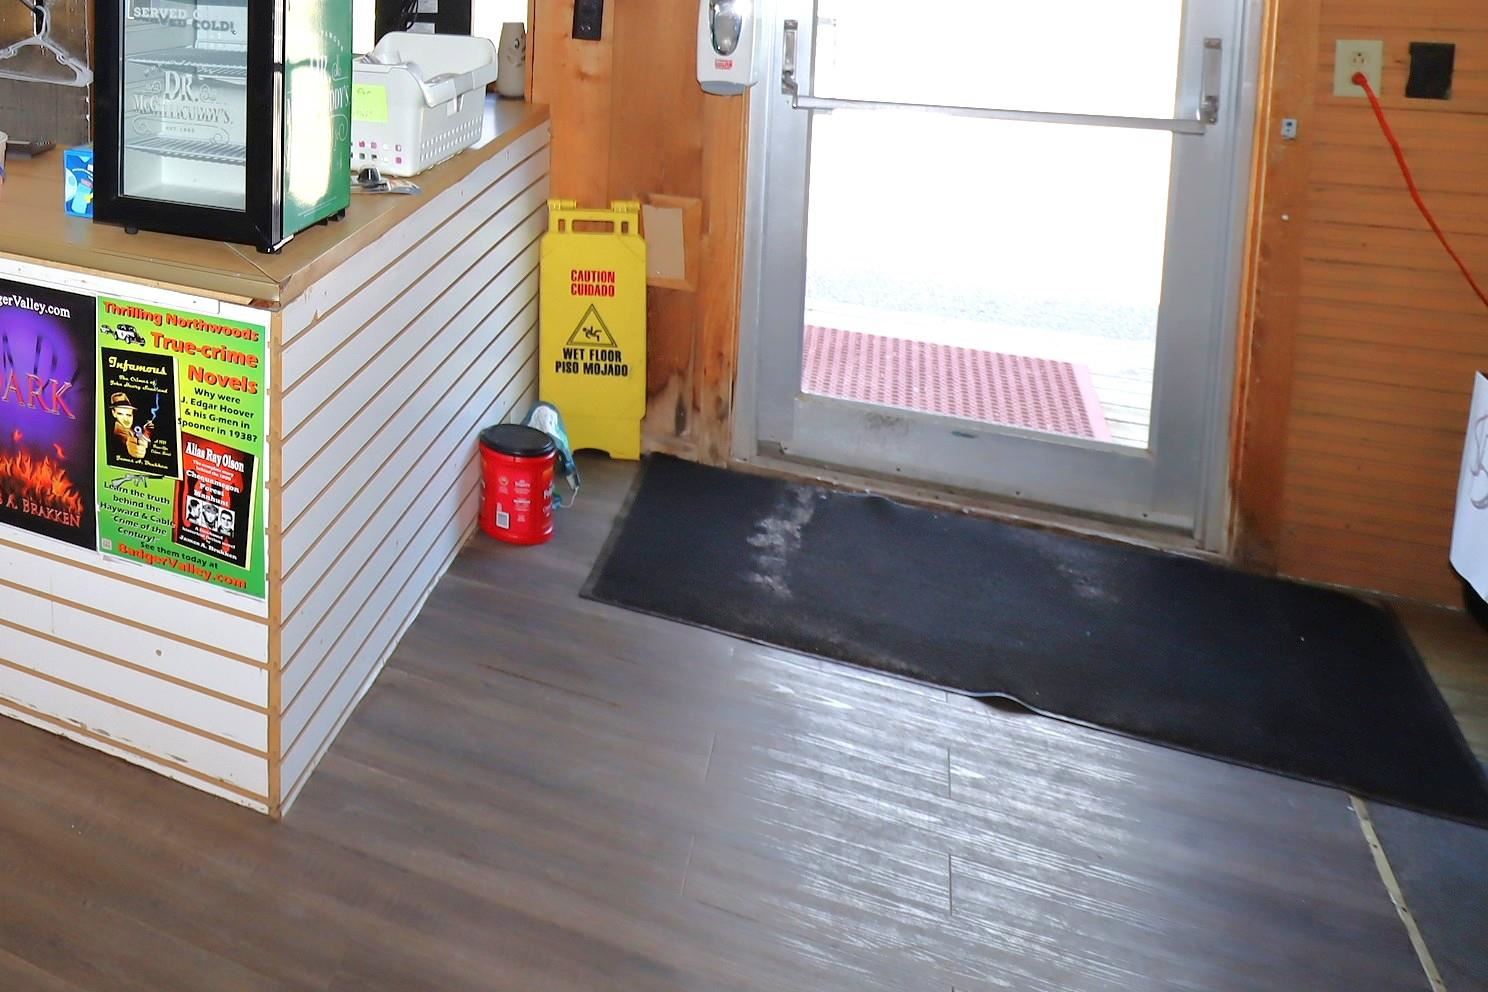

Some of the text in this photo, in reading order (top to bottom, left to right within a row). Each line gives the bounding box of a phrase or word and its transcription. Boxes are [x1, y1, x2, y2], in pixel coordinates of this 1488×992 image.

[133, 6, 187, 23] SERVED
[164, 71, 198, 101] DR.
[570, 269, 615, 283] CAUTION
[570, 283, 615, 297] CUIDADO
[103, 301, 260, 342] Thrilling Northwoods
[151, 331, 260, 368] True-crime
[562, 347, 622, 363] WET FLOOR
[108, 356, 168, 376] Infamous
[555, 361, 629, 377] PISO MOJADO
[187, 364, 258, 394] Novels
[194, 387, 241, 404] Why were
[180, 396, 255, 419] J. Edgar Hoover
[184, 408, 250, 429] & his G-men in
[177, 416, 257, 443] Spooner in 1938?
[185, 441, 206, 459] Alias
[206, 447, 223, 467] Ray
[222, 454, 245, 473] Olson
[185, 469, 240, 493] Chequamegon
[199, 482, 225, 497] Forest
[103, 481, 170, 505] Learn the truth
[113, 494, 161, 513] behind the
[193, 489, 230, 507] Manhunt
[7, 494, 18, 510] A.
[22, 496, 81, 528] BRAKKEN
[99, 501, 176, 528] Hayward & Cable
[140, 522, 150, 531] of
[151, 525, 167, 535] the
[118, 542, 247, 589] BadgerValley.com
[140, 541, 218, 569] See them today at
